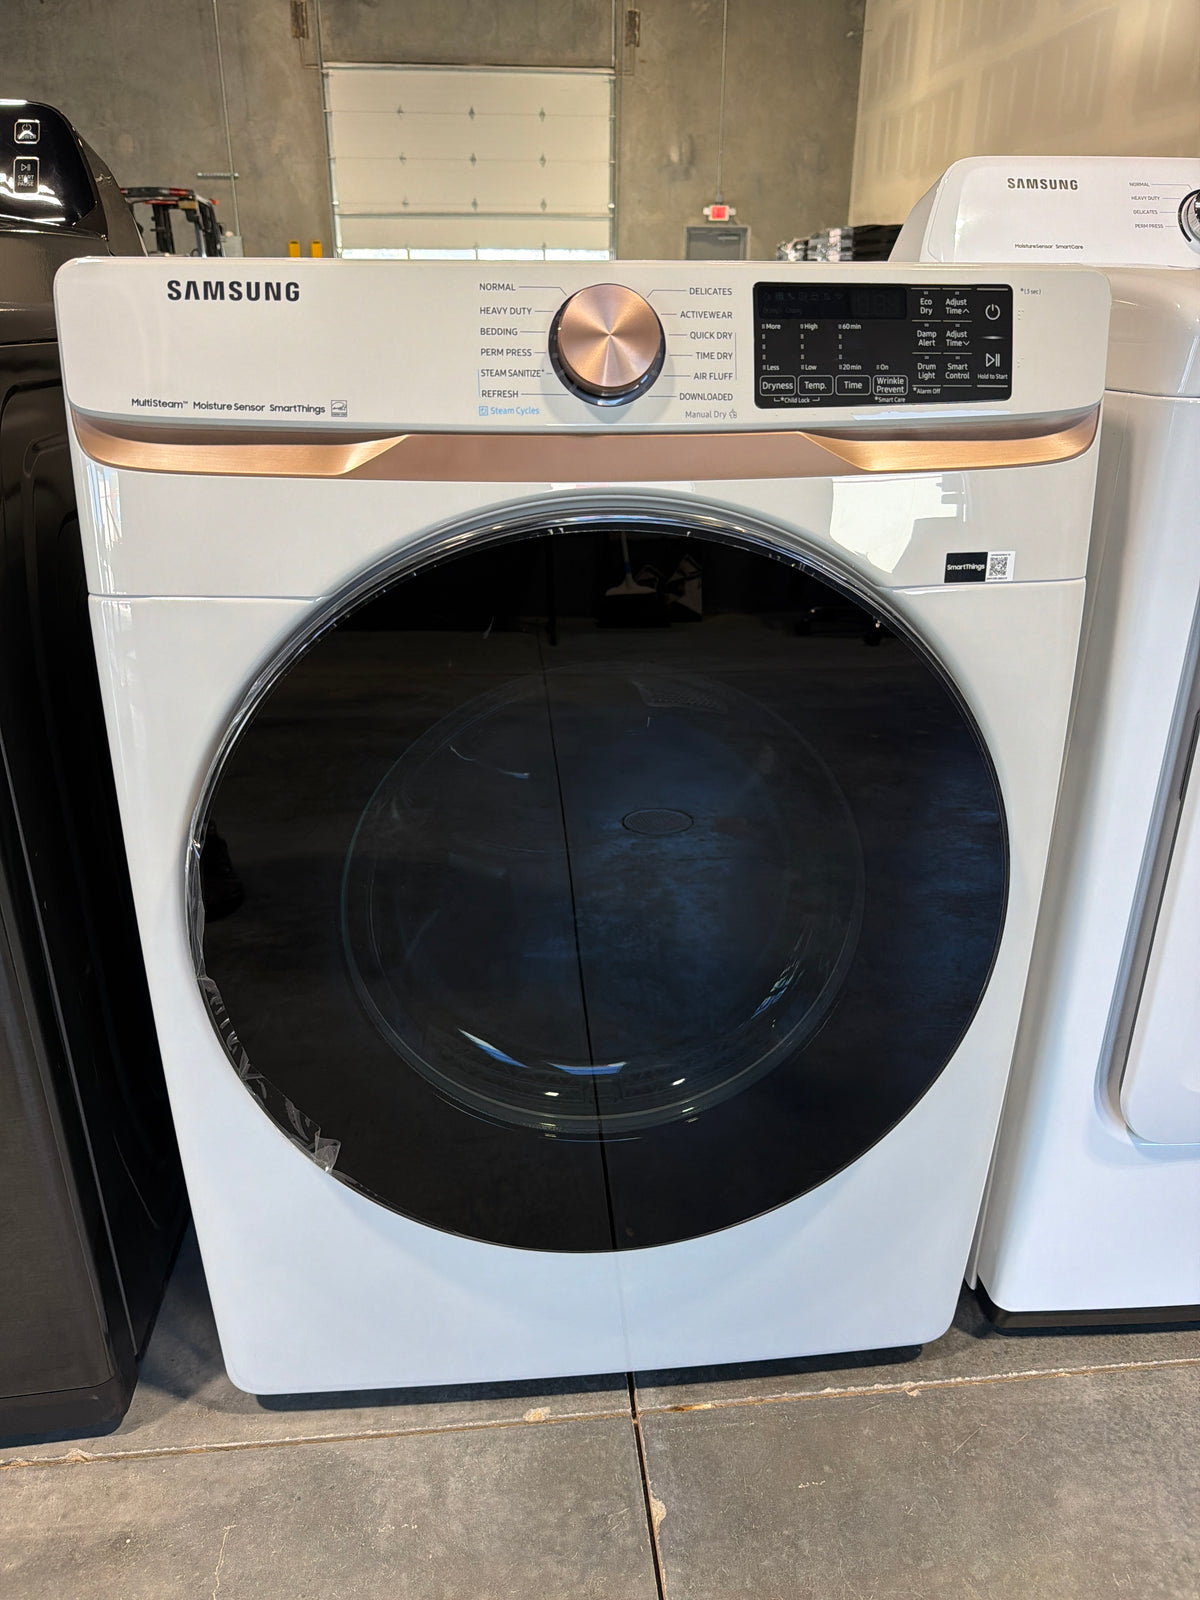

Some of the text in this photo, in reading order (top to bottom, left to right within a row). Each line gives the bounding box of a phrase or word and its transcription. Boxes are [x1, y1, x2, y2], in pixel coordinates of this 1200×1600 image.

[1007, 178, 1079, 190] SAMSUNG
[167, 279, 300, 302] SAMSUNG
[479, 283, 516, 291] NORMAL
[689, 288, 732, 296] DELICATES
[920, 298, 932, 306] Eco
[945, 298, 967, 307] Adjust
[480, 307, 532, 315] HEAVY DUTY
[680, 311, 733, 319] ACTIVEWEAR
[920, 307, 933, 315] Dry
[946, 307, 962, 315] Time
[804, 323, 818, 331] High
[480, 328, 518, 336] BEDDING
[690, 331, 733, 340] QUICK DRY
[917, 330, 937, 339] Damp
[946, 330, 967, 339] Adjust
[918, 339, 935, 347] Alert
[946, 339, 962, 347] Time
[481, 349, 532, 357] PERM PRESS
[696, 352, 733, 360] TIME DRY
[917, 363, 936, 371] Drum
[947, 363, 968, 371] Smart
[481, 369, 506, 377] STEAM
[693, 372, 733, 380] AIR FLUFF
[918, 372, 935, 381] Light
[945, 372, 970, 380] Control
[844, 381, 863, 389] Time
[877, 377, 905, 385] Wrinkle
[763, 381, 793, 391] Dryness
[804, 381, 827, 391] Temp.
[877, 386, 905, 394] Prevent
[482, 390, 519, 398] REFRESH
[679, 393, 733, 401] DOWNLOADED
[193, 401, 266, 412] Moisture Sensor
[269, 404, 326, 415] SmartThings
[490, 406, 539, 416] Steam Cycles
[685, 410, 727, 420] Manual Dry
